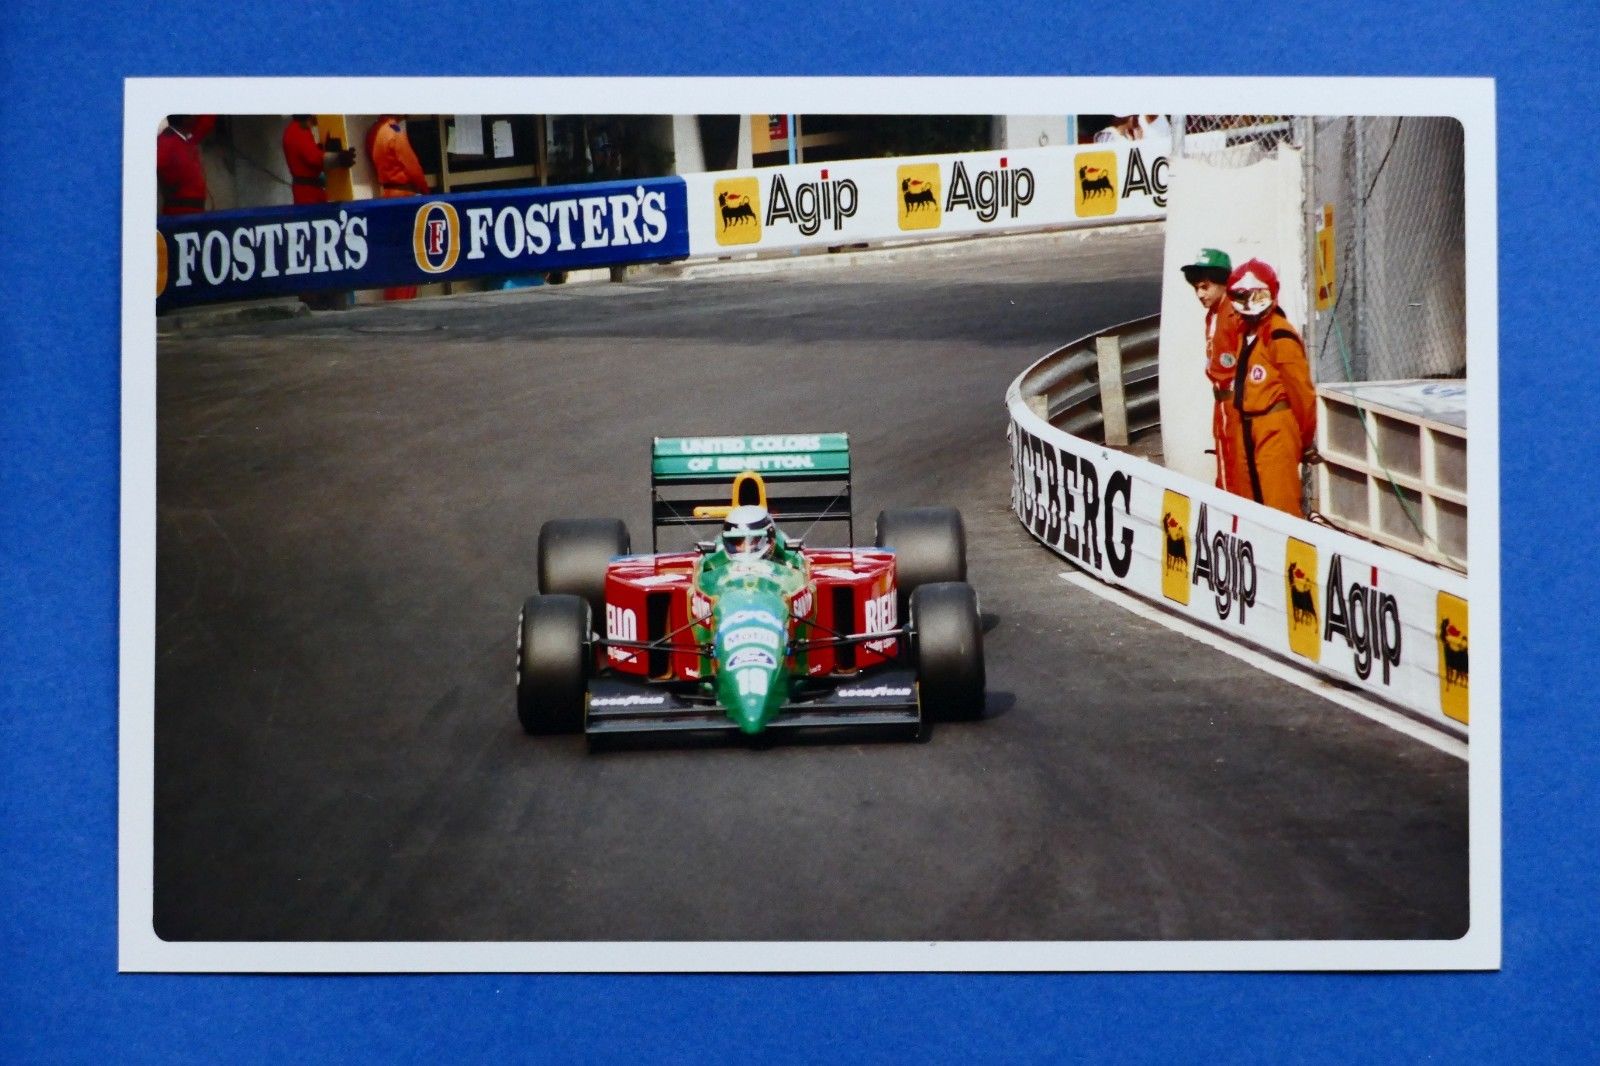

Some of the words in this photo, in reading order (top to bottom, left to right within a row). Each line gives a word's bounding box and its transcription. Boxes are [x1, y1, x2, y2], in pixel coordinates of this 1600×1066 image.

[467, 185, 668, 260] FOSTER'S
[765, 168, 858, 236] Agip
[944, 157, 1035, 223] Agip
[174, 209, 368, 287] FOSTER'S
[681, 438, 746, 453] UNITED
[751, 436, 821, 451] COLORS
[1192, 502, 1257, 625] Agip
[1324, 552, 1402, 686] Agip
